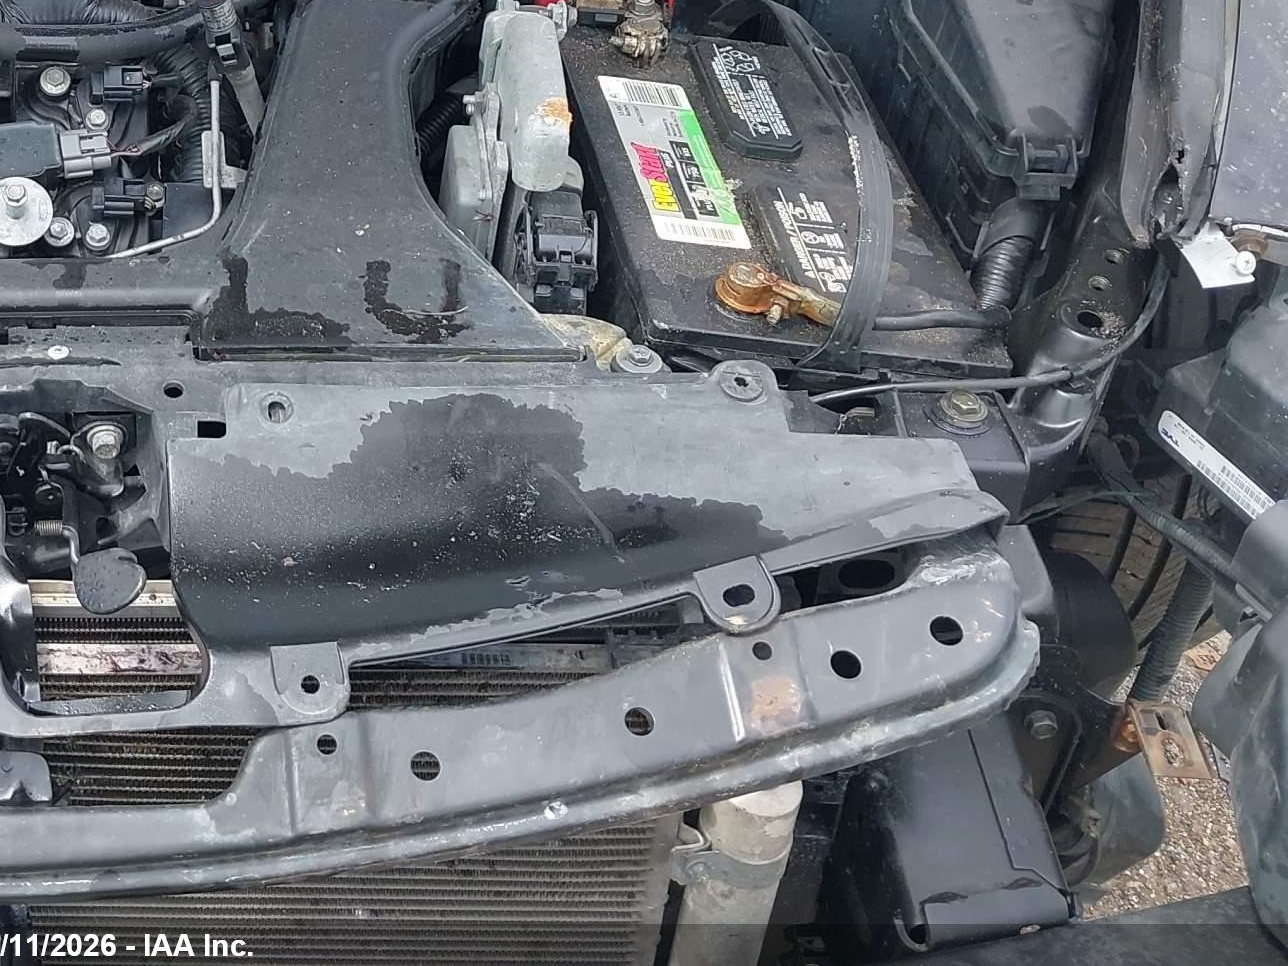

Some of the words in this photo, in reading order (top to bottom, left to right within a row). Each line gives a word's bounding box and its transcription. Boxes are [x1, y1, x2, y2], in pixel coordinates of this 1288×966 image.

[630, 141, 682, 213] EverStart
[772, 200, 795, 230] POISON
[789, 236, 814, 270] DANGER
